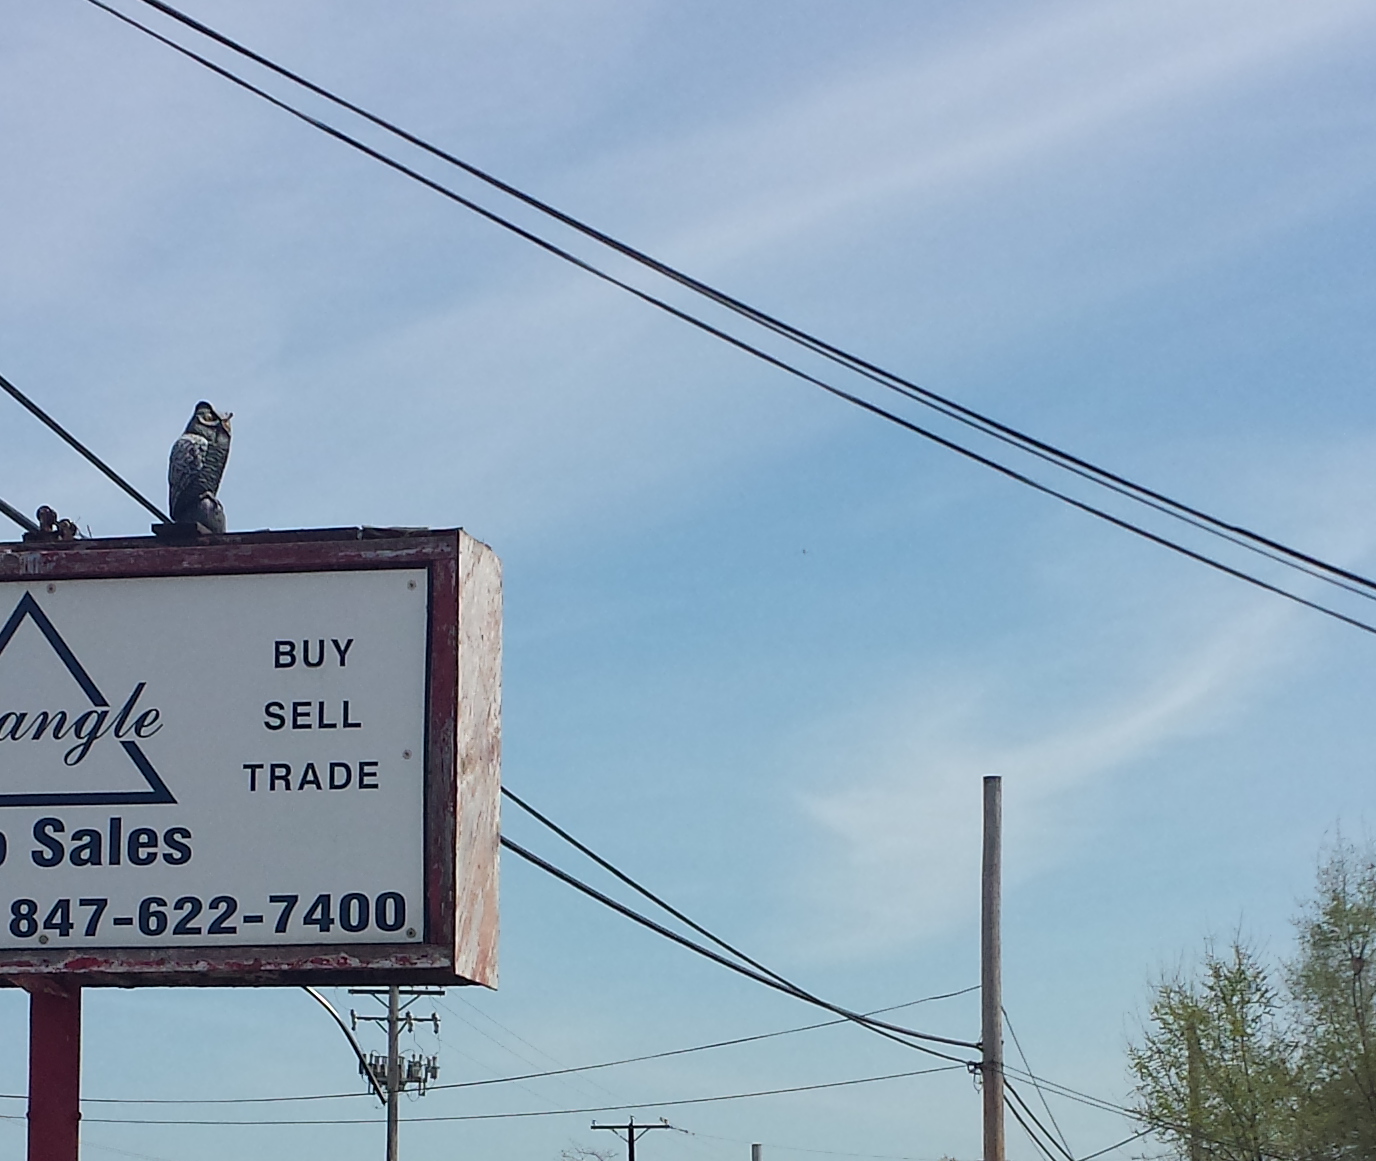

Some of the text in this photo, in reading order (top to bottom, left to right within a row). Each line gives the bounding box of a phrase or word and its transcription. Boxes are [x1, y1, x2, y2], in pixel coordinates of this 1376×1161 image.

[274, 638, 354, 669] BUY
[263, 700, 362, 731] SELL
[242, 761, 379, 792] TRADE
[31, 817, 193, 868] Sales
[8, 891, 407, 939] 847-622-7400
